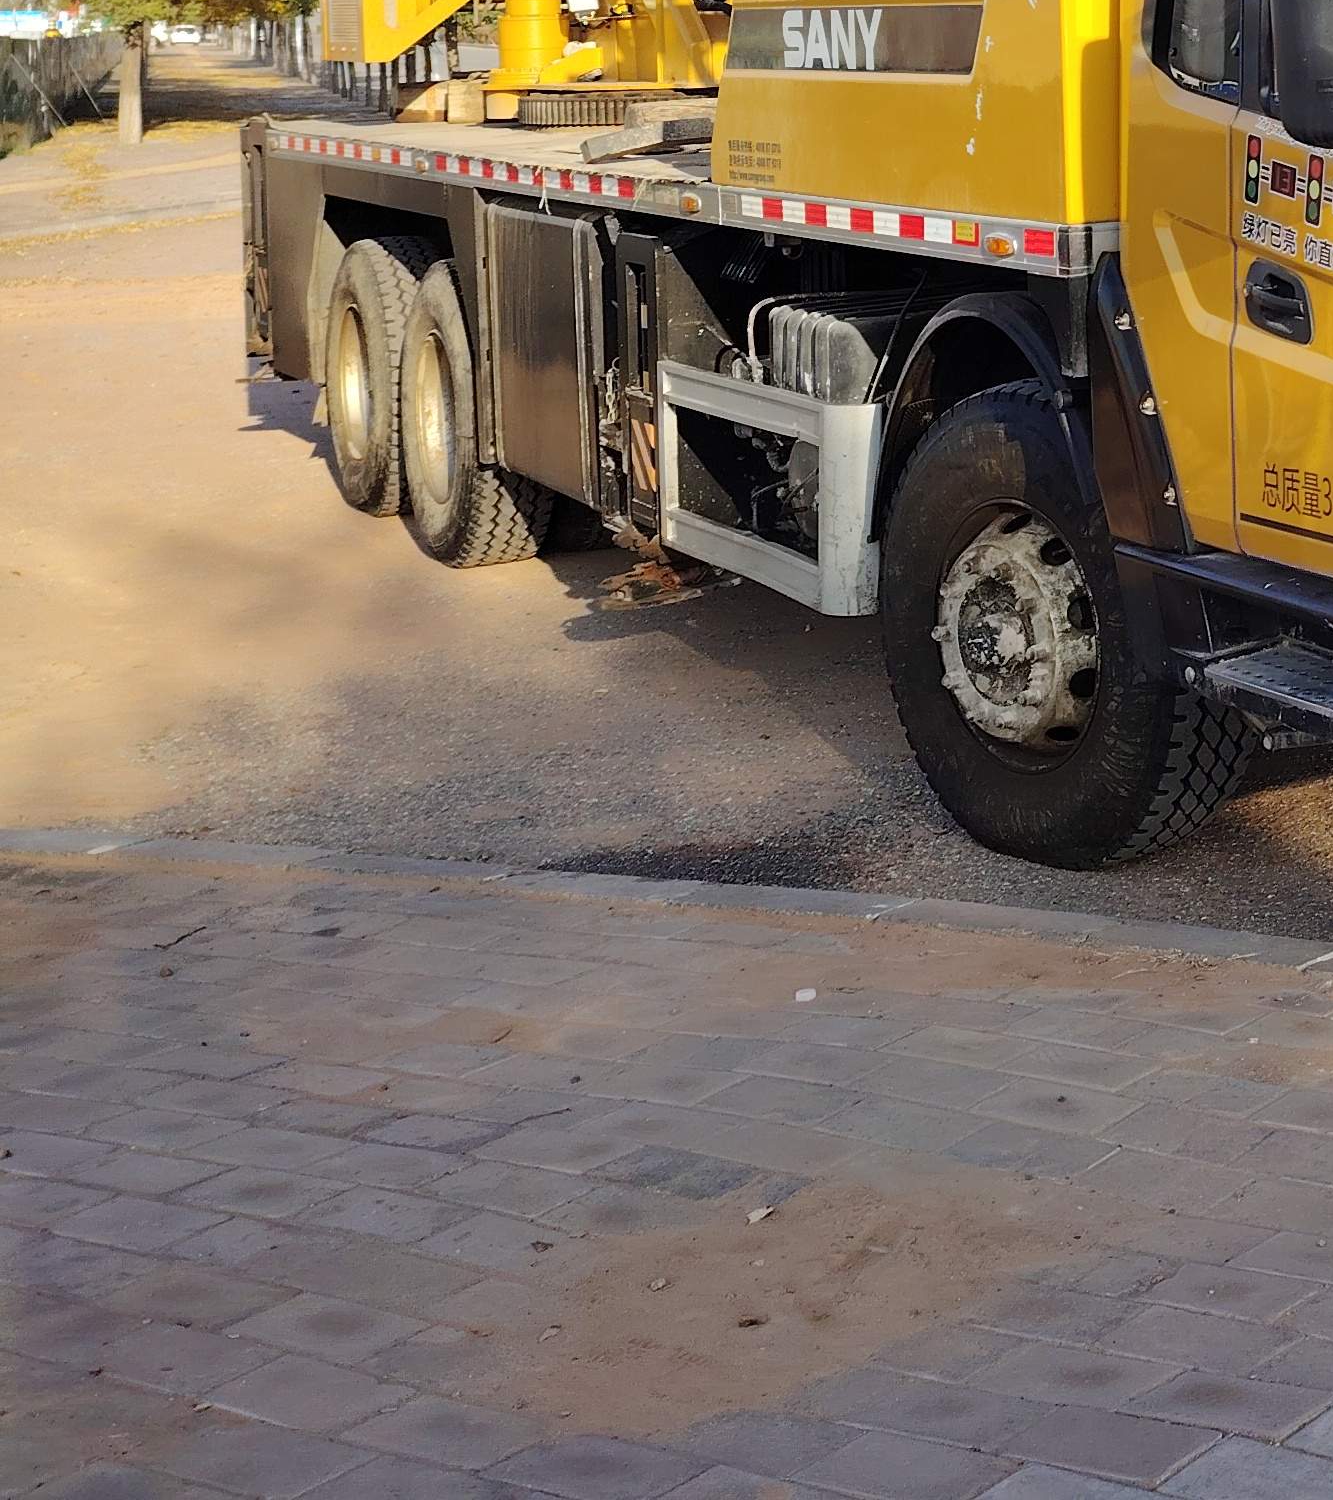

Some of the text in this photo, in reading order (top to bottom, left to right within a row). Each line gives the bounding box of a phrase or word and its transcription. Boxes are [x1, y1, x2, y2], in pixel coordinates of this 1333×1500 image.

[783, 9, 882, 71] SANY
[1242, 212, 1297, 255] 绿灯已亮
